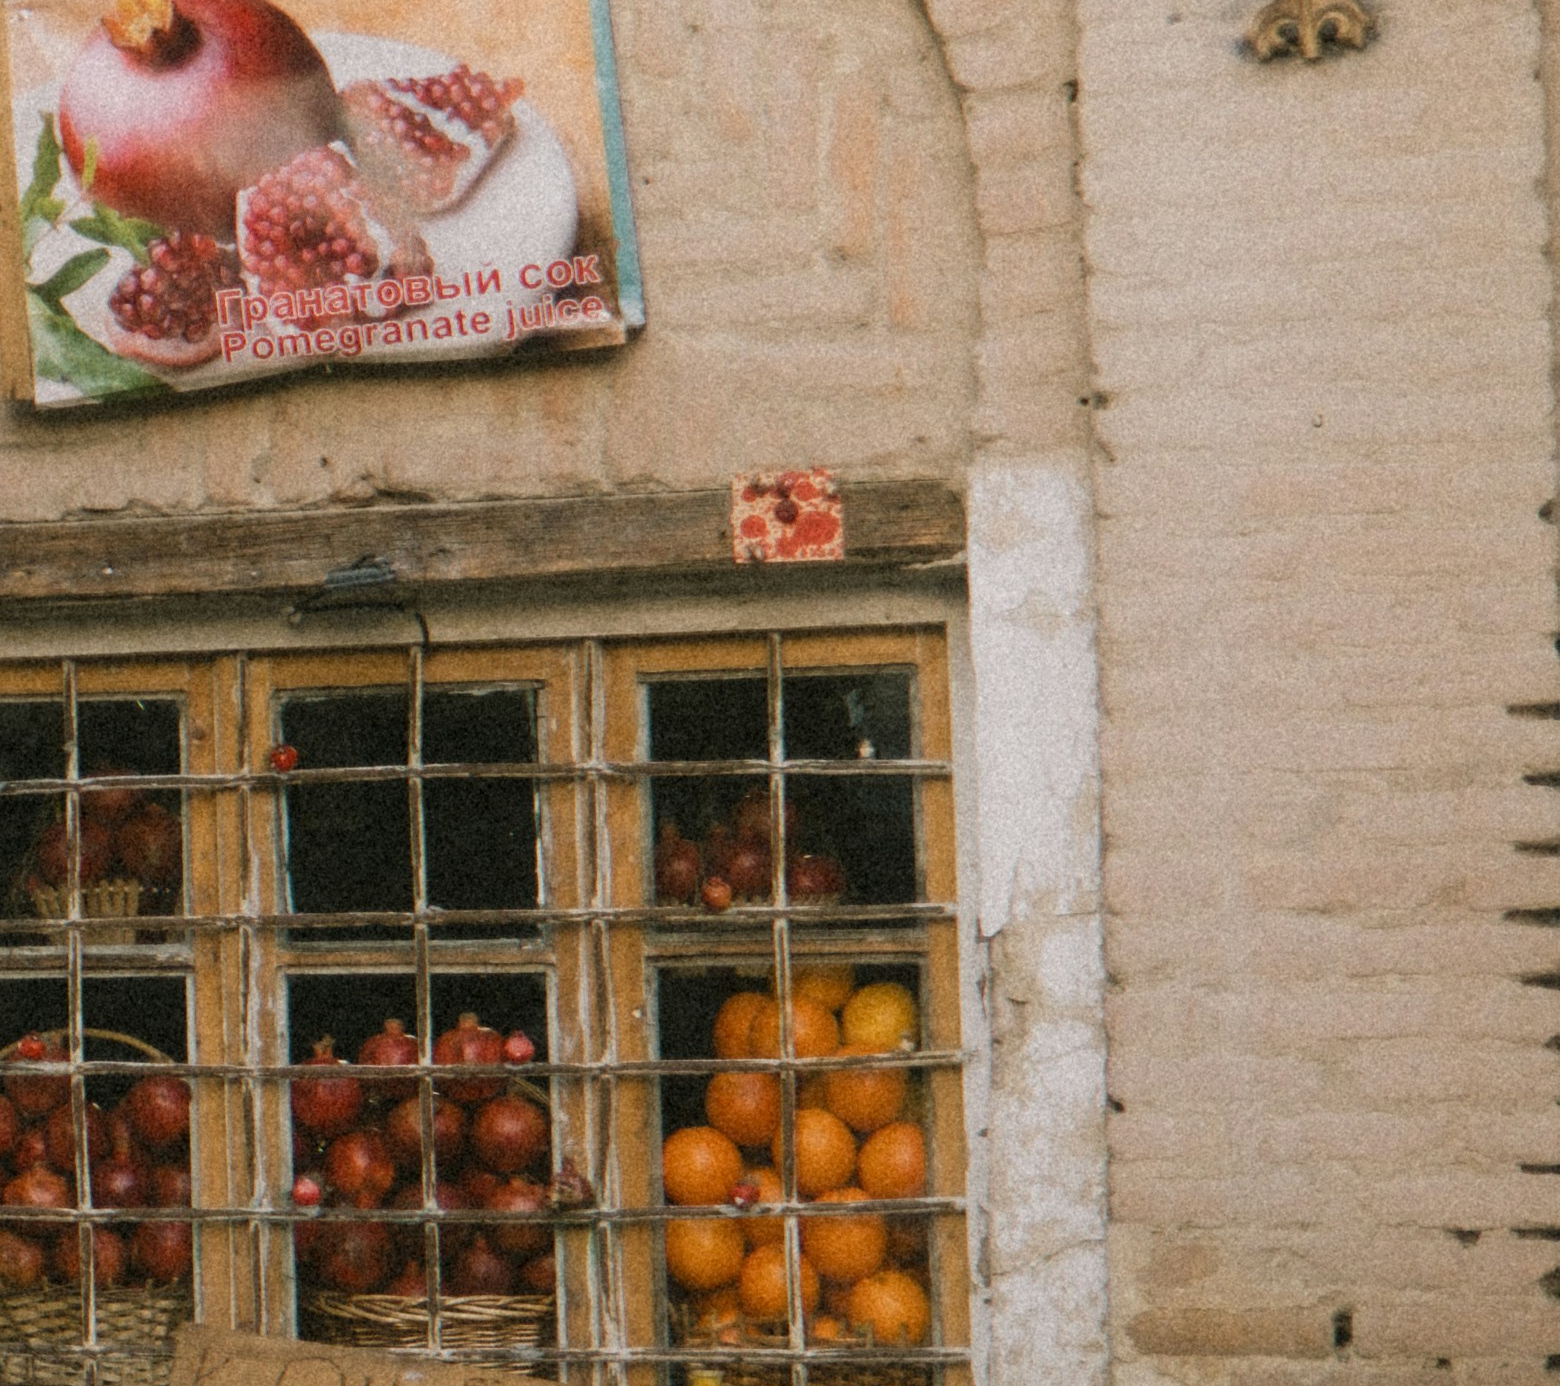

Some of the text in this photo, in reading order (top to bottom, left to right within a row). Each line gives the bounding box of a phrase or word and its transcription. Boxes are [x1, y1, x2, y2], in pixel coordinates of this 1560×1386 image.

[216, 254, 601, 330] Гранатовый сок
[221, 293, 604, 363] Pomegranate juice
